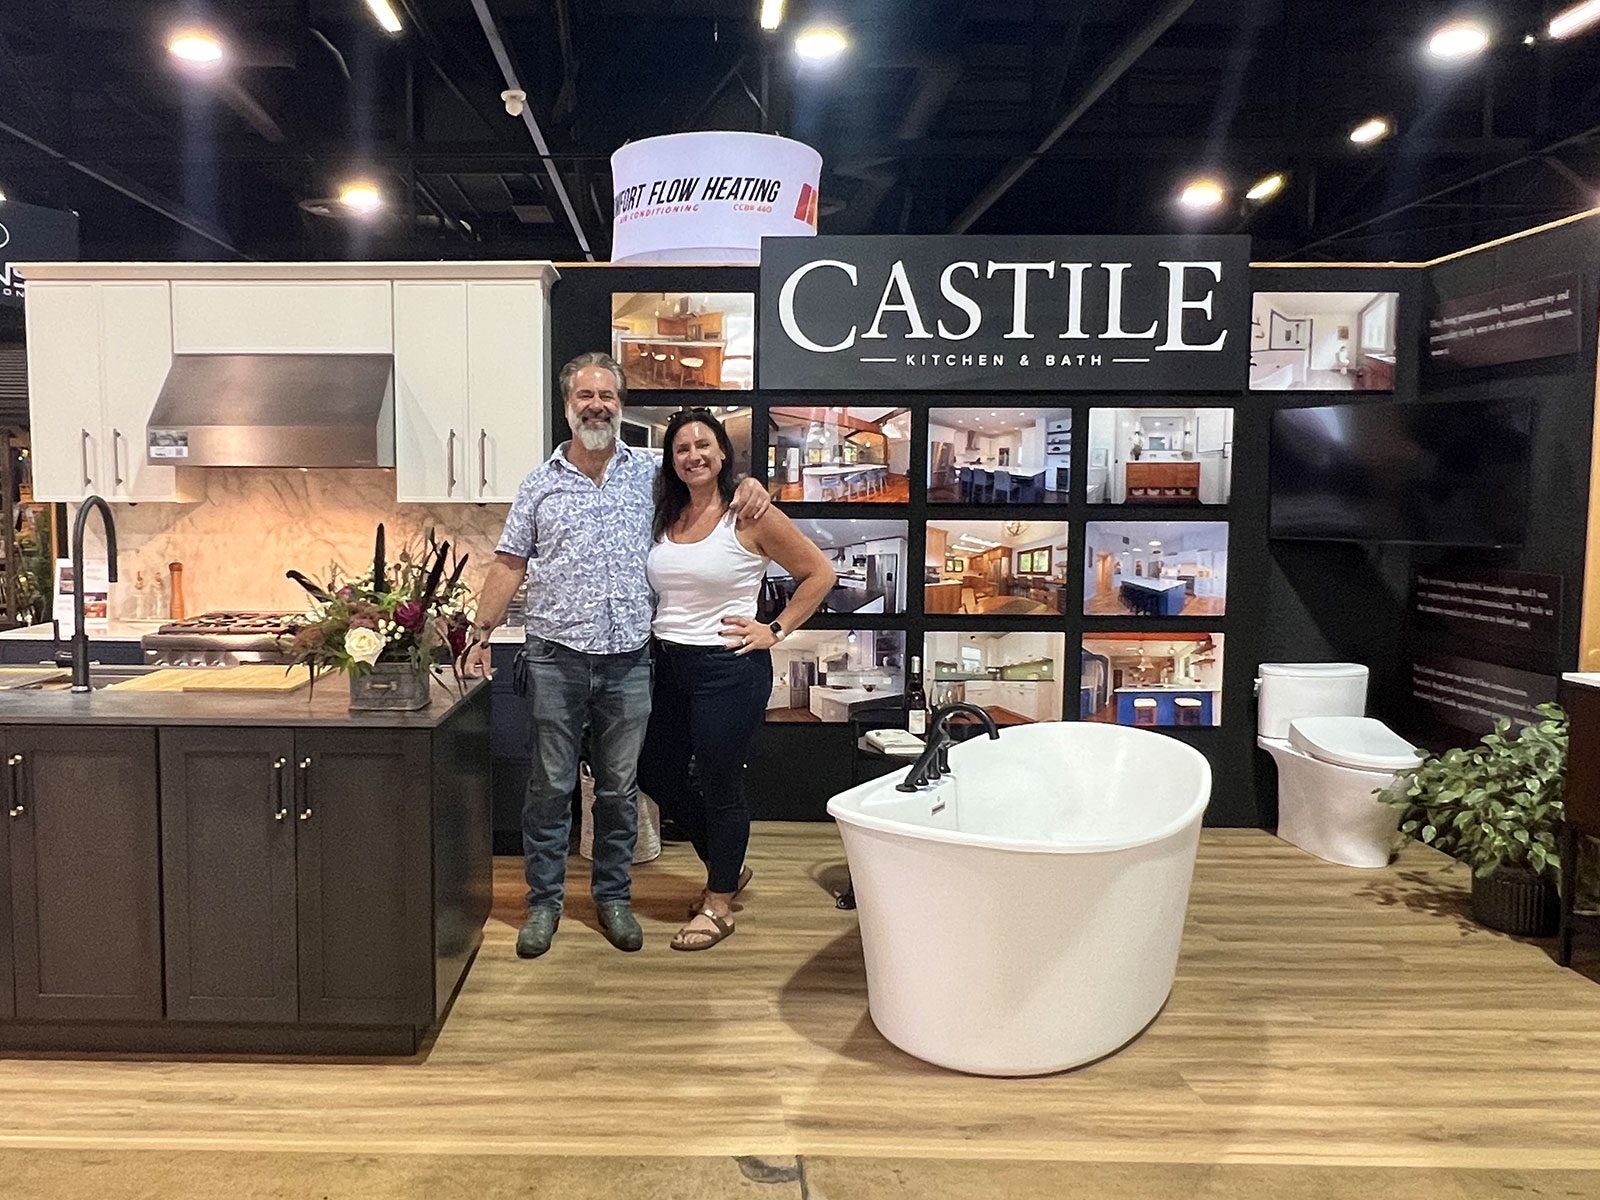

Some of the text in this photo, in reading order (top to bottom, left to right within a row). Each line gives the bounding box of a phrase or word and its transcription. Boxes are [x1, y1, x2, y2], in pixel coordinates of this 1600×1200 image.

[648, 177, 701, 205] FLOW
[701, 176, 781, 203] HEATING
[630, 204, 700, 220] CONDITIONING
[778, 260, 1228, 353] CASTILE
[906, 354, 1102, 366] KITCHEN & BATH
